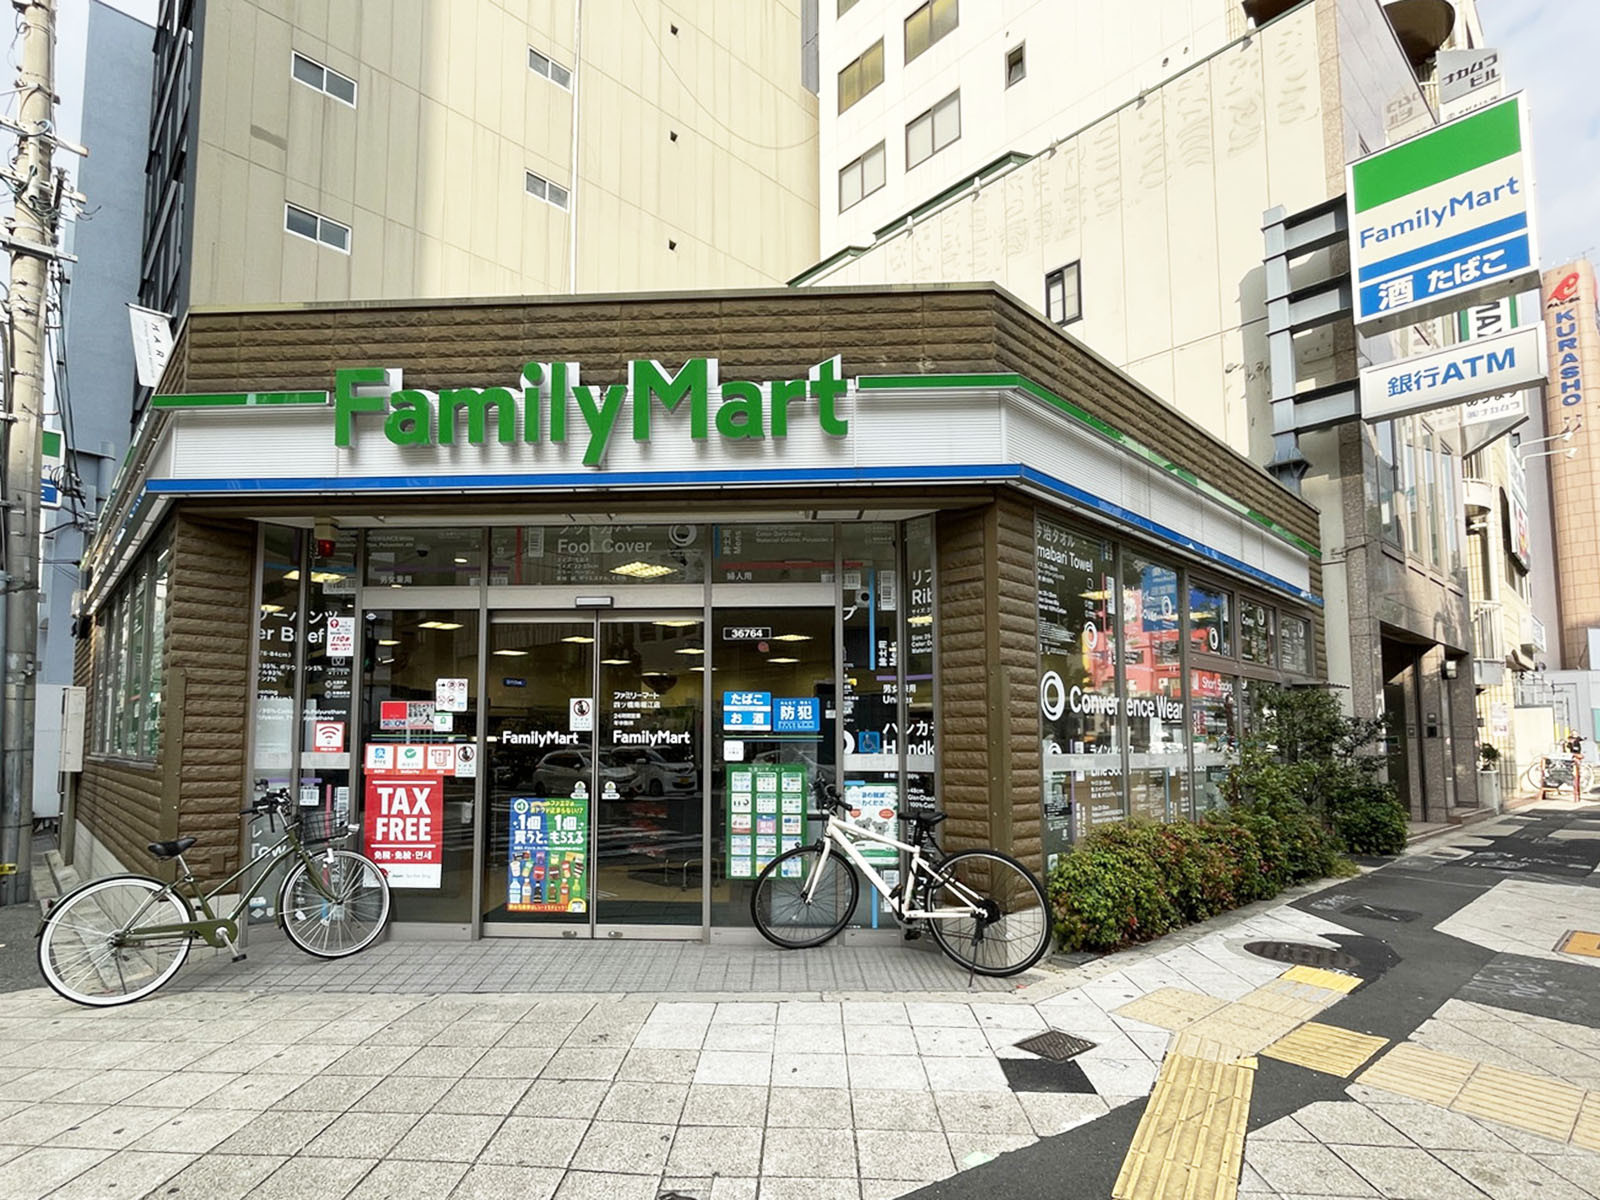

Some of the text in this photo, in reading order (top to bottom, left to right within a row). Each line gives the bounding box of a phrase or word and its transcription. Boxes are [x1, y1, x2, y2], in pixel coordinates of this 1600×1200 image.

[1360, 176, 1520, 249] FamilyMart
[1378, 249, 1508, 310] 酒 たばこ
[1556, 308, 1582, 407] KURASHO
[1387, 347, 1516, 398] 銀行ATM
[334, 357, 849, 468] FamilyMart
[601, 539, 653, 553] Cover
[1069, 551, 1093, 573] Towel
[731, 629, 763, 638] 36764
[613, 691, 660, 700] ファミリーマート
[731, 693, 764, 705] たばこ
[1069, 685, 1155, 717] Conveence
[1155, 695, 1184, 719] Wear
[780, 705, 812, 720] 防犯
[502, 730, 579, 748] FamilyMart
[612, 730, 691, 747] FamilyMart
[377, 787, 431, 815] TAX
[376, 817, 432, 841] FREE
